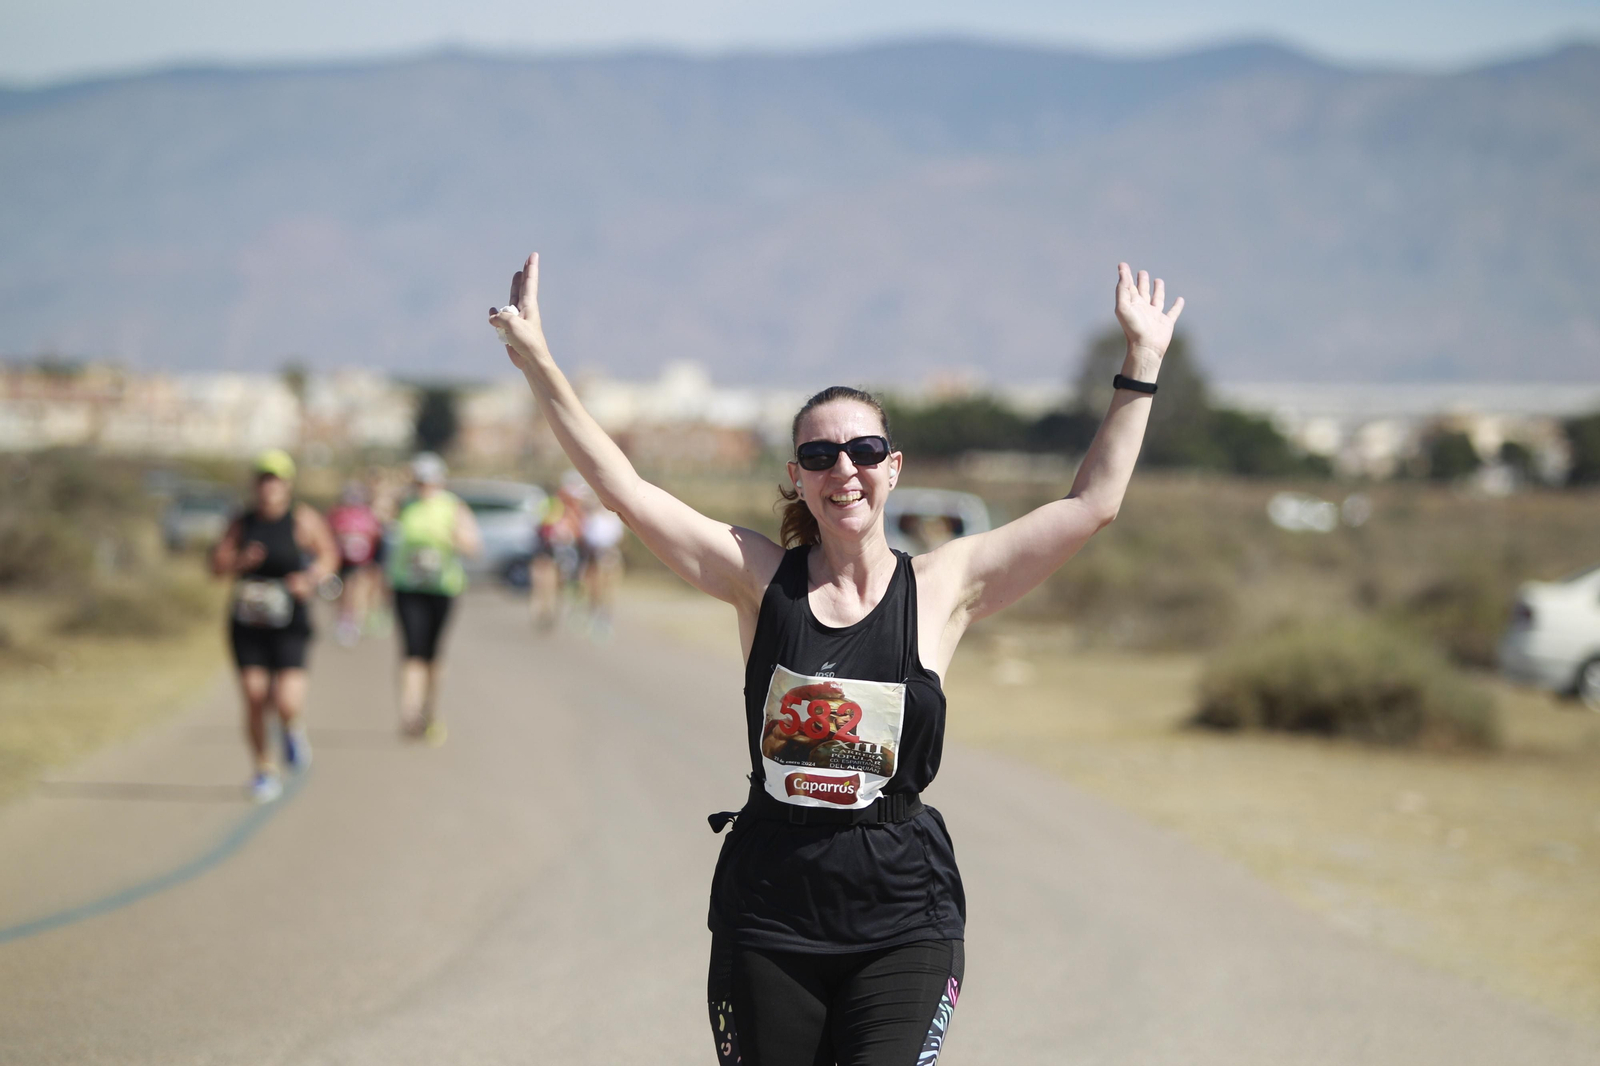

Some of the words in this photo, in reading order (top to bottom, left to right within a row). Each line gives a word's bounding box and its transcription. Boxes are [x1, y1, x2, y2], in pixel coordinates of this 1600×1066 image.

[778, 694, 863, 743] 582
[831, 748, 883, 760] CARRERA
[832, 739, 883, 755] XIII
[831, 753, 881, 765] POPULAR
